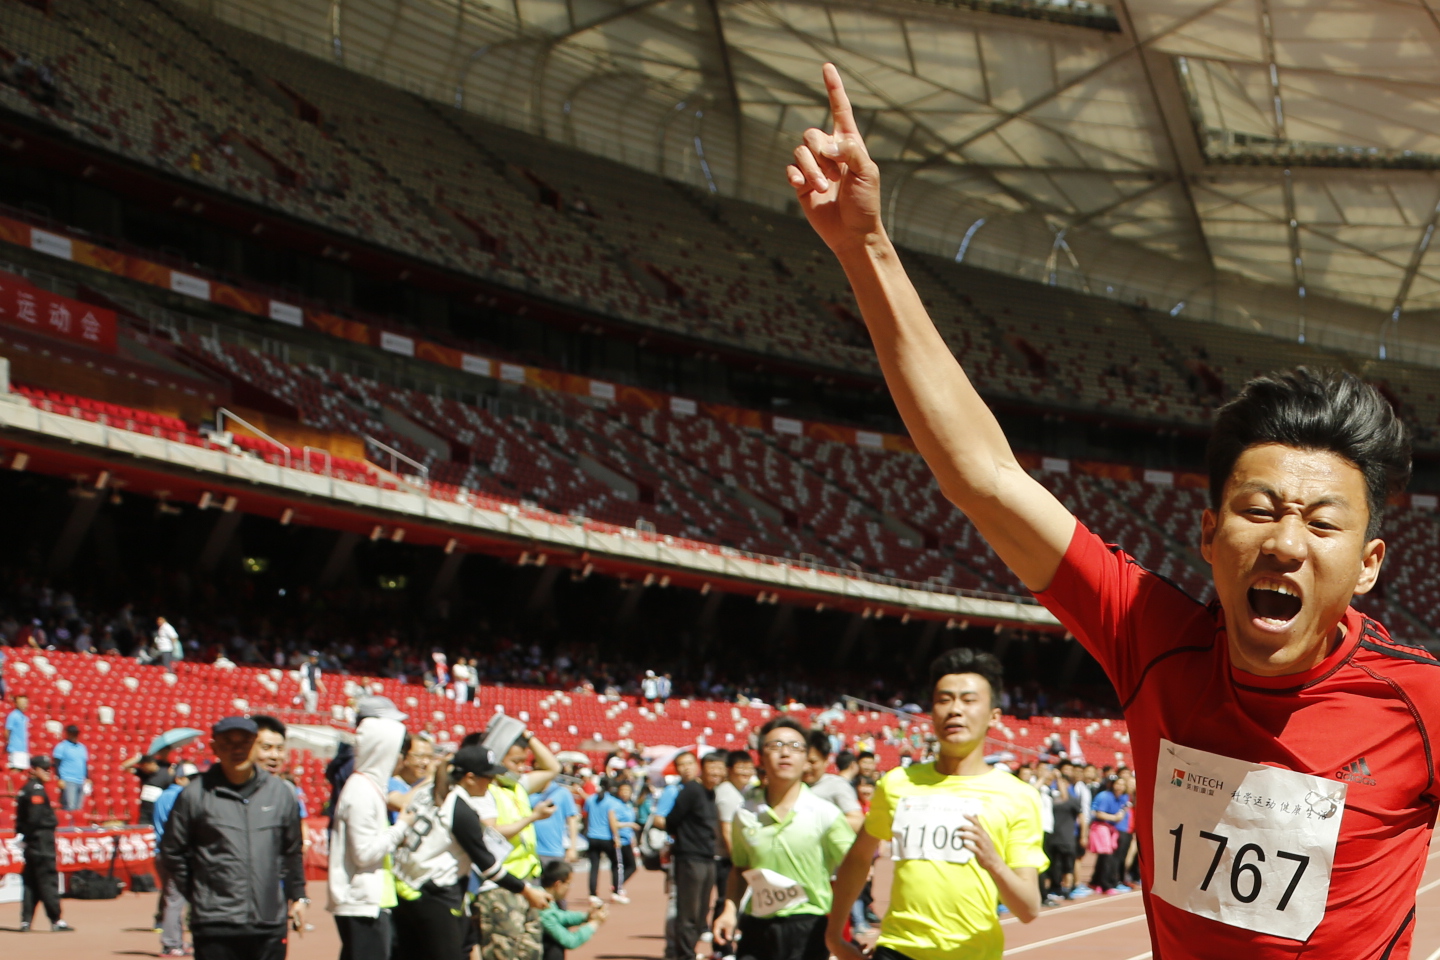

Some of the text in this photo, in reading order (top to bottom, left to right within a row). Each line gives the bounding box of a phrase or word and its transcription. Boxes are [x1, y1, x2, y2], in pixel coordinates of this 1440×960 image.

[0, 284, 101, 341] 运动会
[1187, 773, 1224, 790] INTECH
[1335, 771, 1377, 786] adidas
[902, 825, 965, 850] 1106
[1169, 823, 1310, 912] 1767
